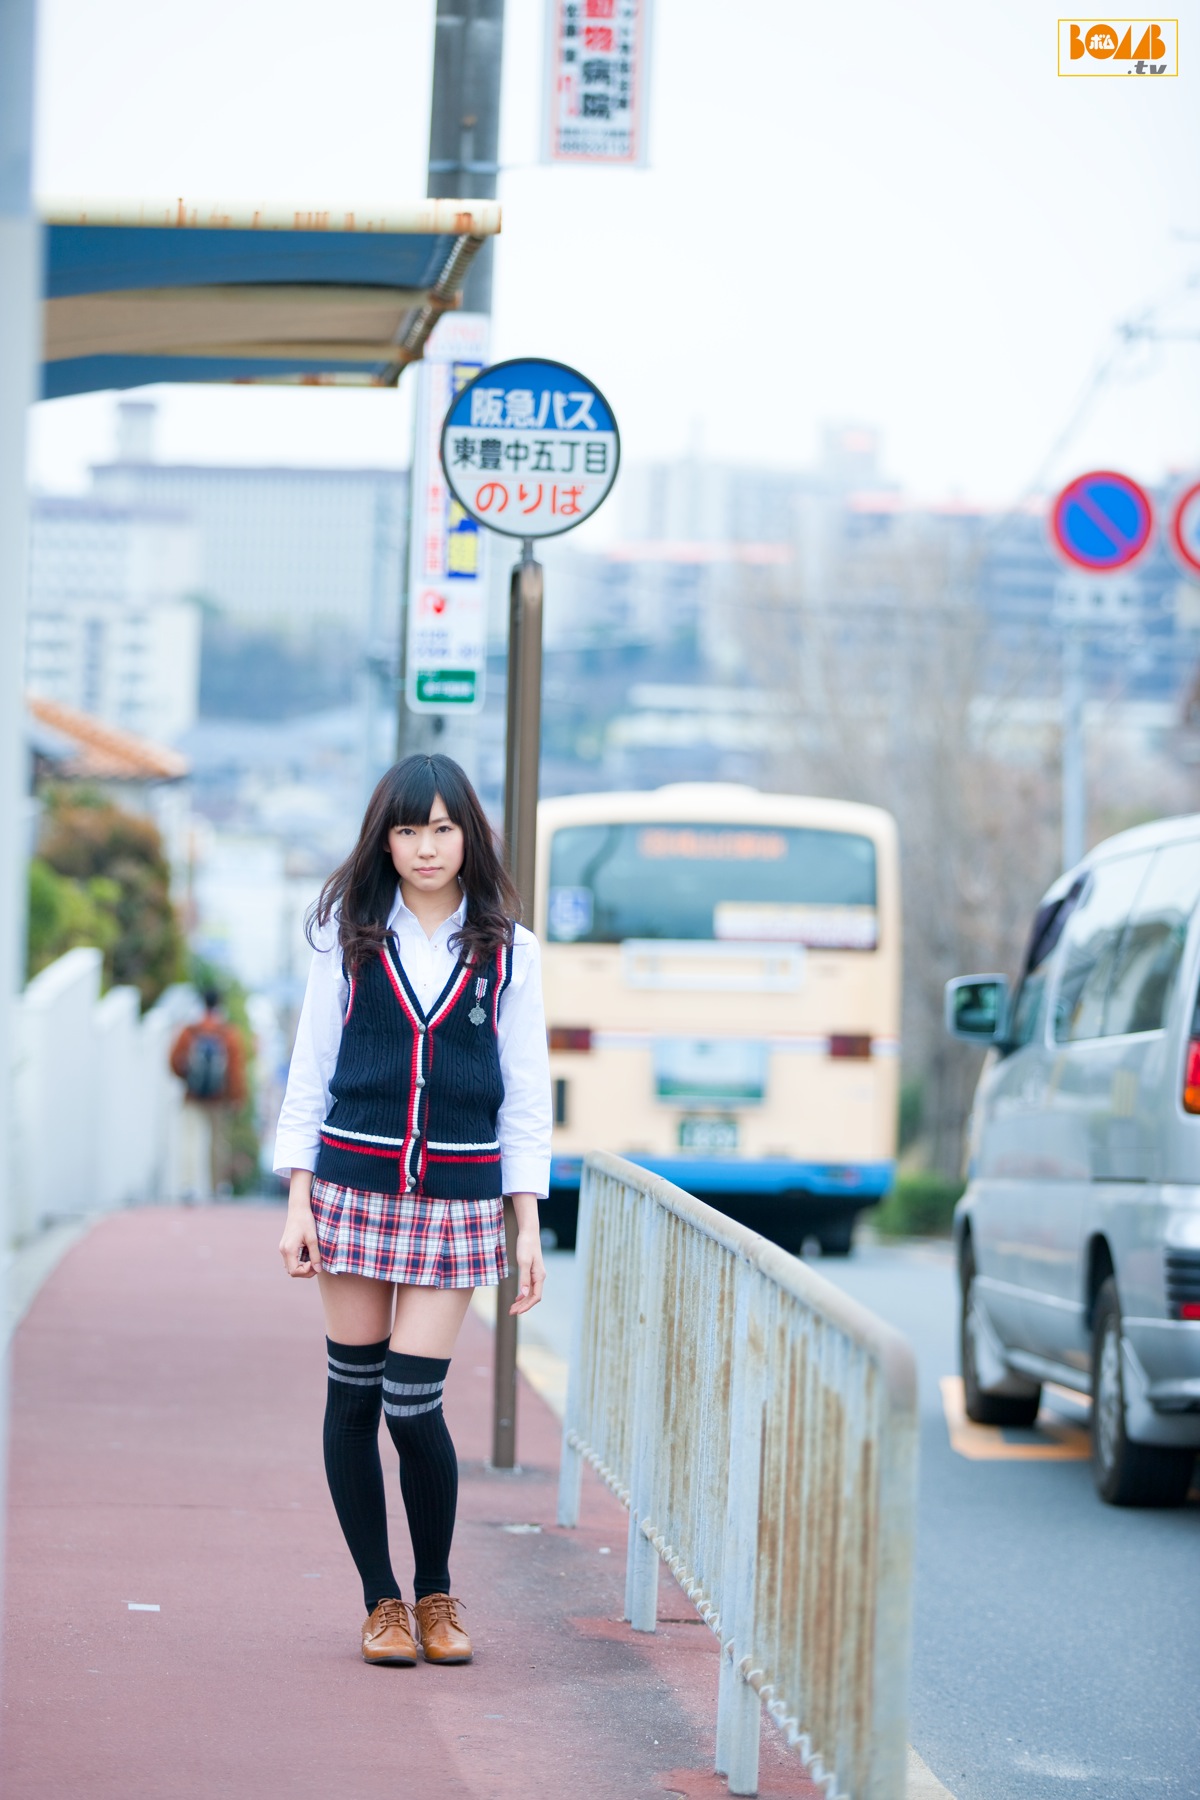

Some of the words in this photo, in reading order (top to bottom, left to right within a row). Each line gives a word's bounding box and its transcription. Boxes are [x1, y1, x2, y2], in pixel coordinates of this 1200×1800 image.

[470, 388, 598, 430] 阪急バス
[453, 437, 608, 474] 東豊中五丁目
[476, 482, 586, 515] のりば
